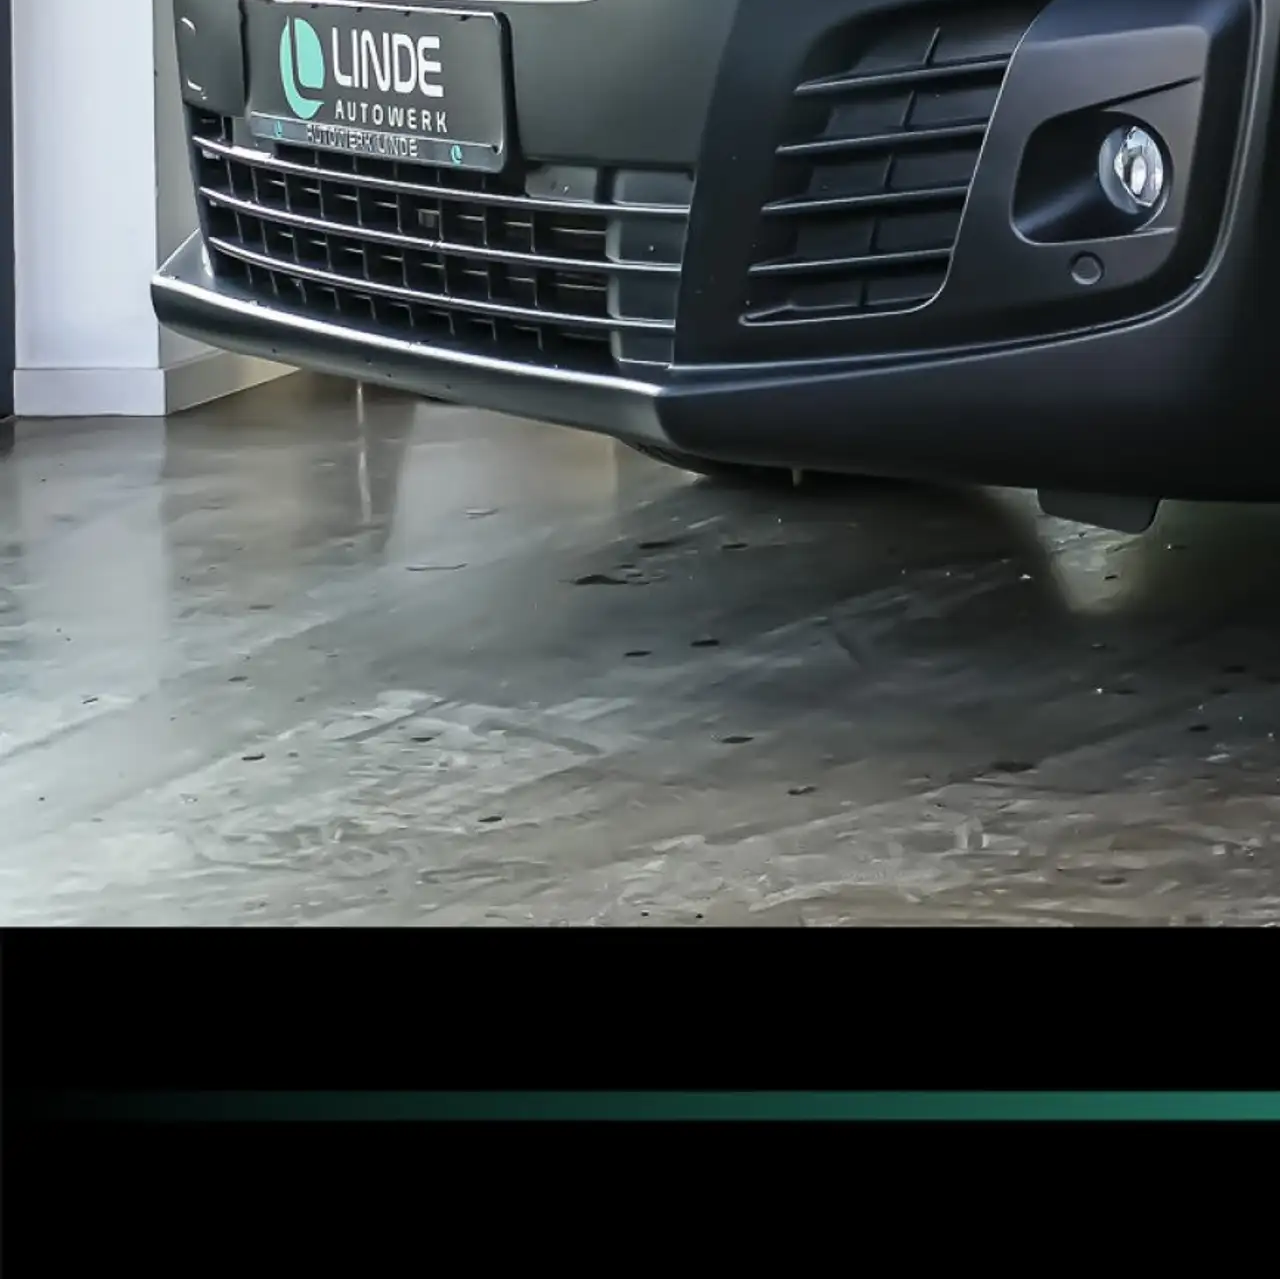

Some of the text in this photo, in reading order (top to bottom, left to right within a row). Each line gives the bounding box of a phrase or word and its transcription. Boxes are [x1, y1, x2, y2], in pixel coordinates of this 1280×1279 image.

[331, 26, 444, 98] LINDE
[334, 98, 449, 133] AUTOWERK
[375, 132, 418, 157] LINDE
